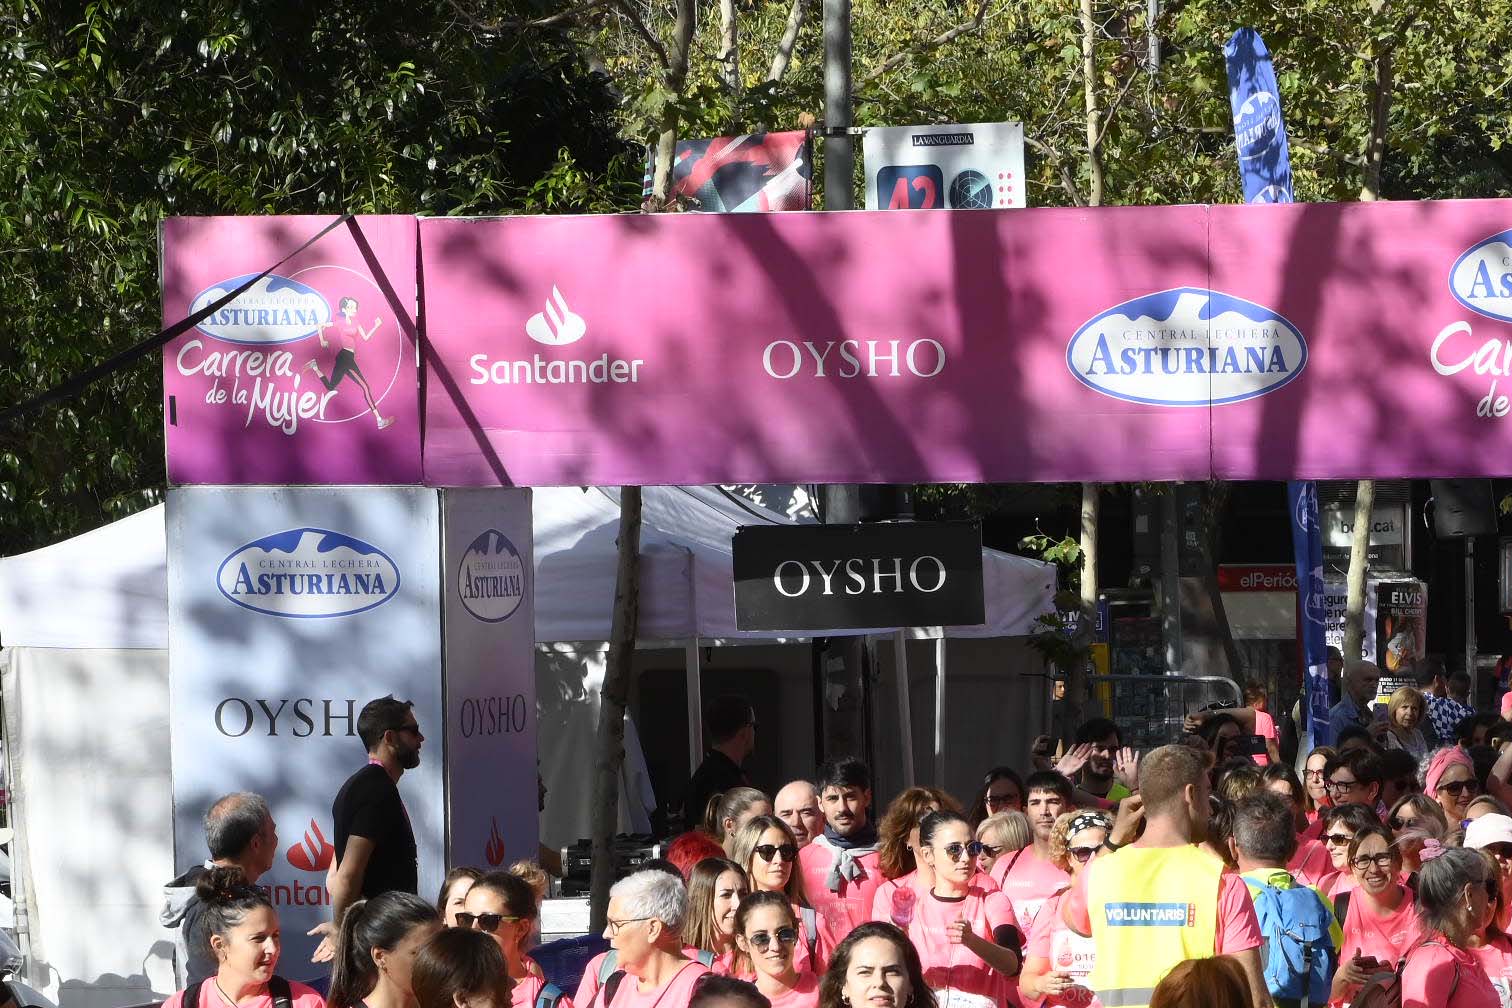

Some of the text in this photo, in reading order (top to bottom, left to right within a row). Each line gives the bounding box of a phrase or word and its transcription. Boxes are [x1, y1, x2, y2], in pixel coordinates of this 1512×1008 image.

[1122, 327, 1280, 341] CENTRAL LECHERA
[177, 340, 294, 377] Carrera
[471, 352, 643, 385] Santander
[762, 339, 946, 379] OYSHO
[1086, 332, 1289, 377] ASTURIANA
[206, 374, 338, 435] de la Mujer
[1476, 380, 1511, 419] de
[231, 562, 387, 597] ASTURIANA
[259, 559, 380, 569] CENTRAL LECHERA
[773, 556, 947, 598] OYSHO
[1240, 571, 1298, 588] elPerió
[463, 565, 521, 601] ASTURIANA
[1391, 591, 1422, 604] ELVIS
[214, 697, 358, 738] OYSH
[460, 694, 527, 739] OYSHO
[1105, 908, 1186, 922] VOLUNTARIS
